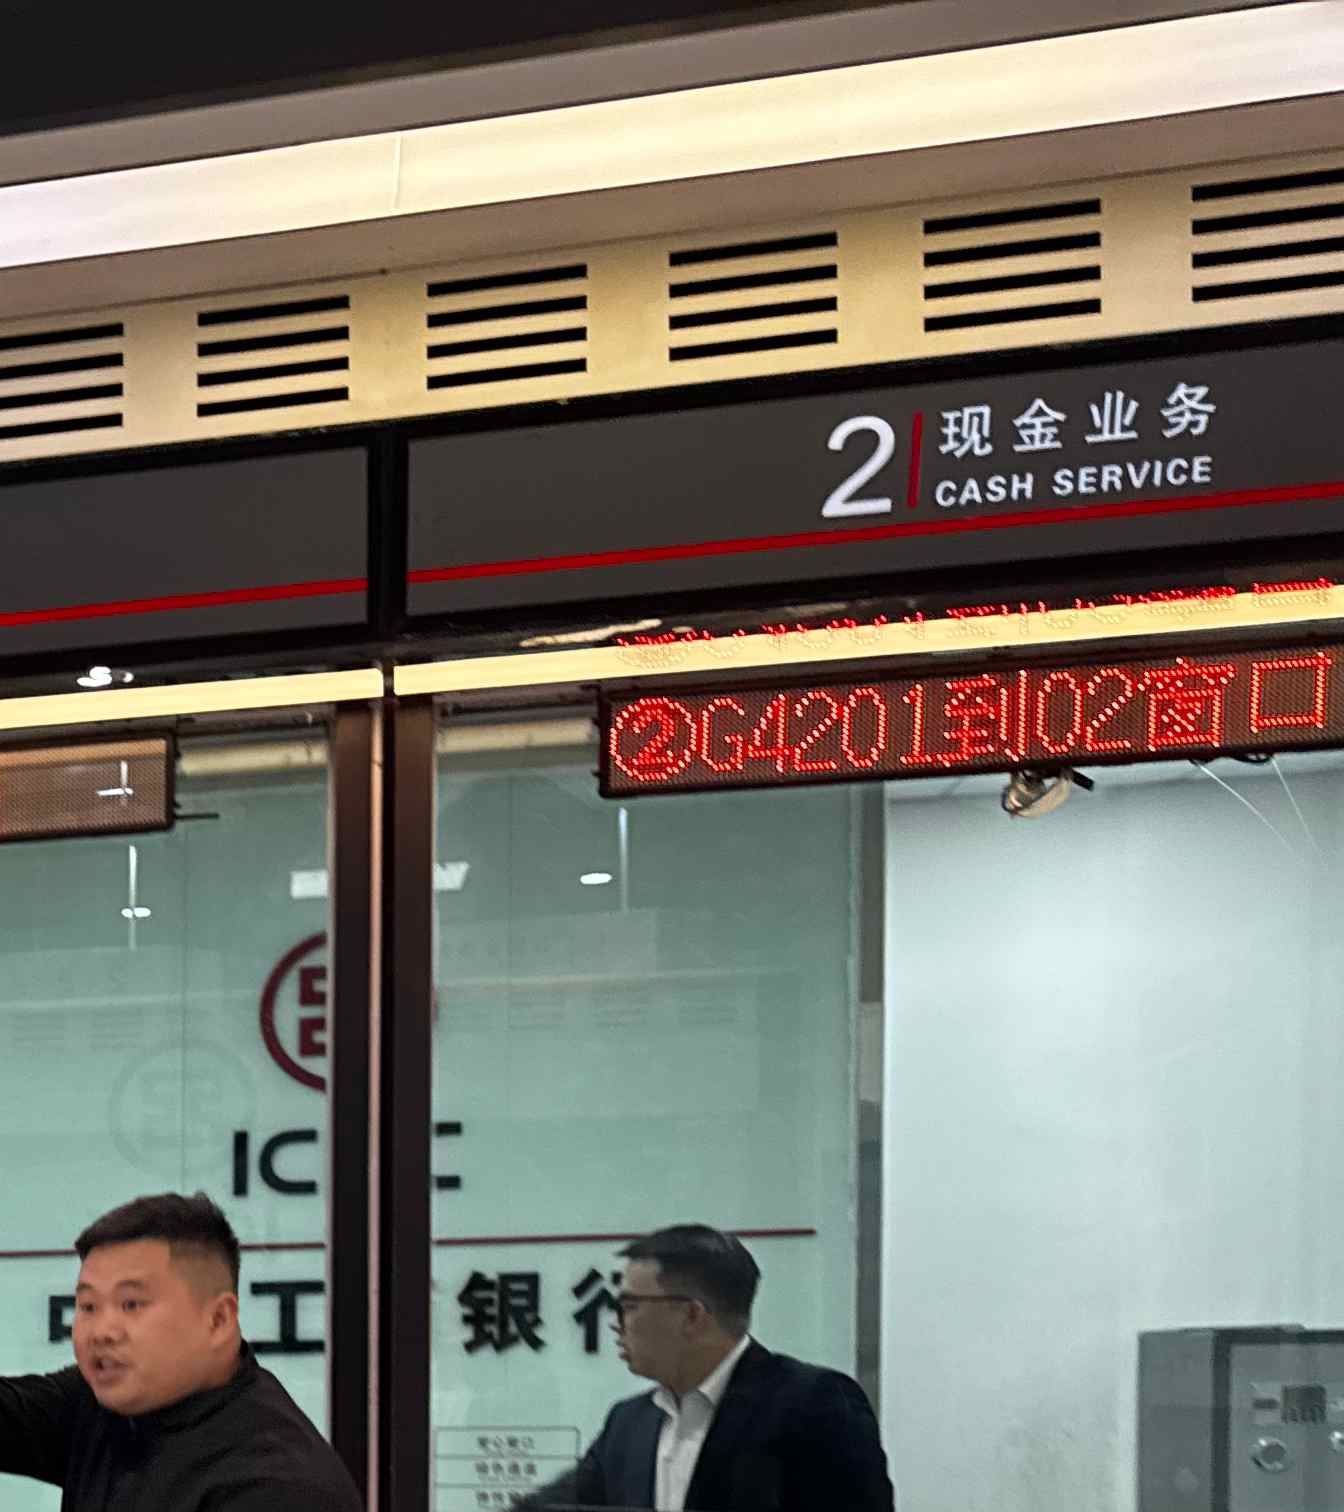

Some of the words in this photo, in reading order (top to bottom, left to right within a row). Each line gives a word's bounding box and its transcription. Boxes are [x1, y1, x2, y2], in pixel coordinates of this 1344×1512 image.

[939, 382, 1216, 459] 现金业务
[821, 415, 895, 518] 2
[935, 471, 1033, 508] CASH
[1052, 455, 1214, 497] SERVICE
